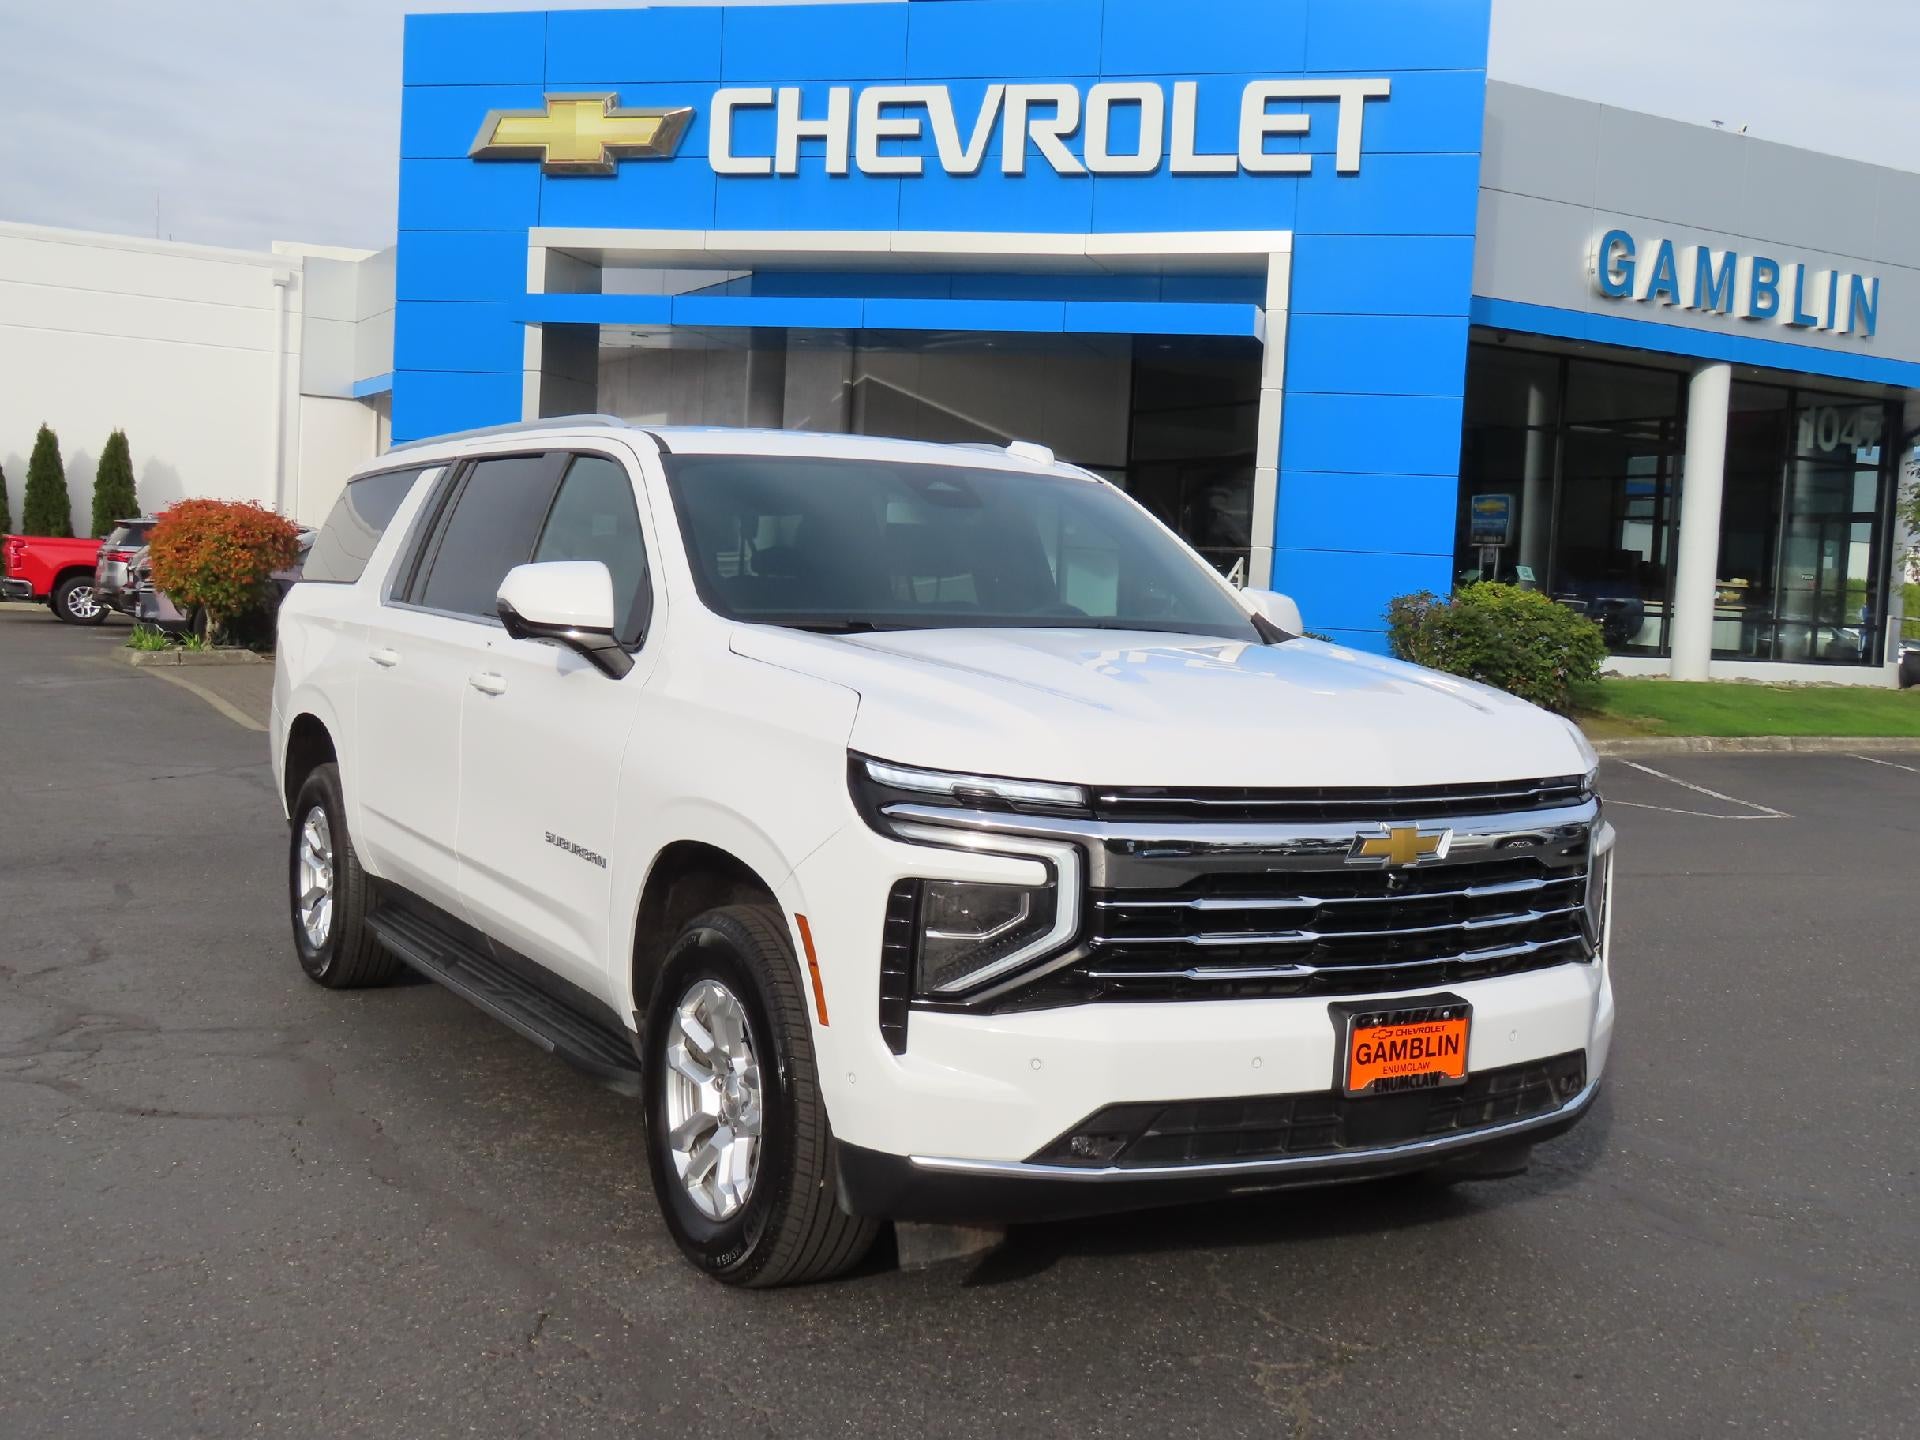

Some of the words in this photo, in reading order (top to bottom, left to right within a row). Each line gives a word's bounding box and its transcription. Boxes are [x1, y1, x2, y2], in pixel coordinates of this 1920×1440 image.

[709, 79, 1391, 176] CHEVROLET
[1598, 229, 1880, 338] GAMBLIN
[545, 831, 607, 868] SUBURBAN
[1396, 1025, 1446, 1037] CHEVROLET
[1355, 1033, 1460, 1066] GAMBLIN
[1373, 1071, 1442, 1093] ENUMCLAW
[1383, 1062, 1431, 1075] ENUMCLAW
